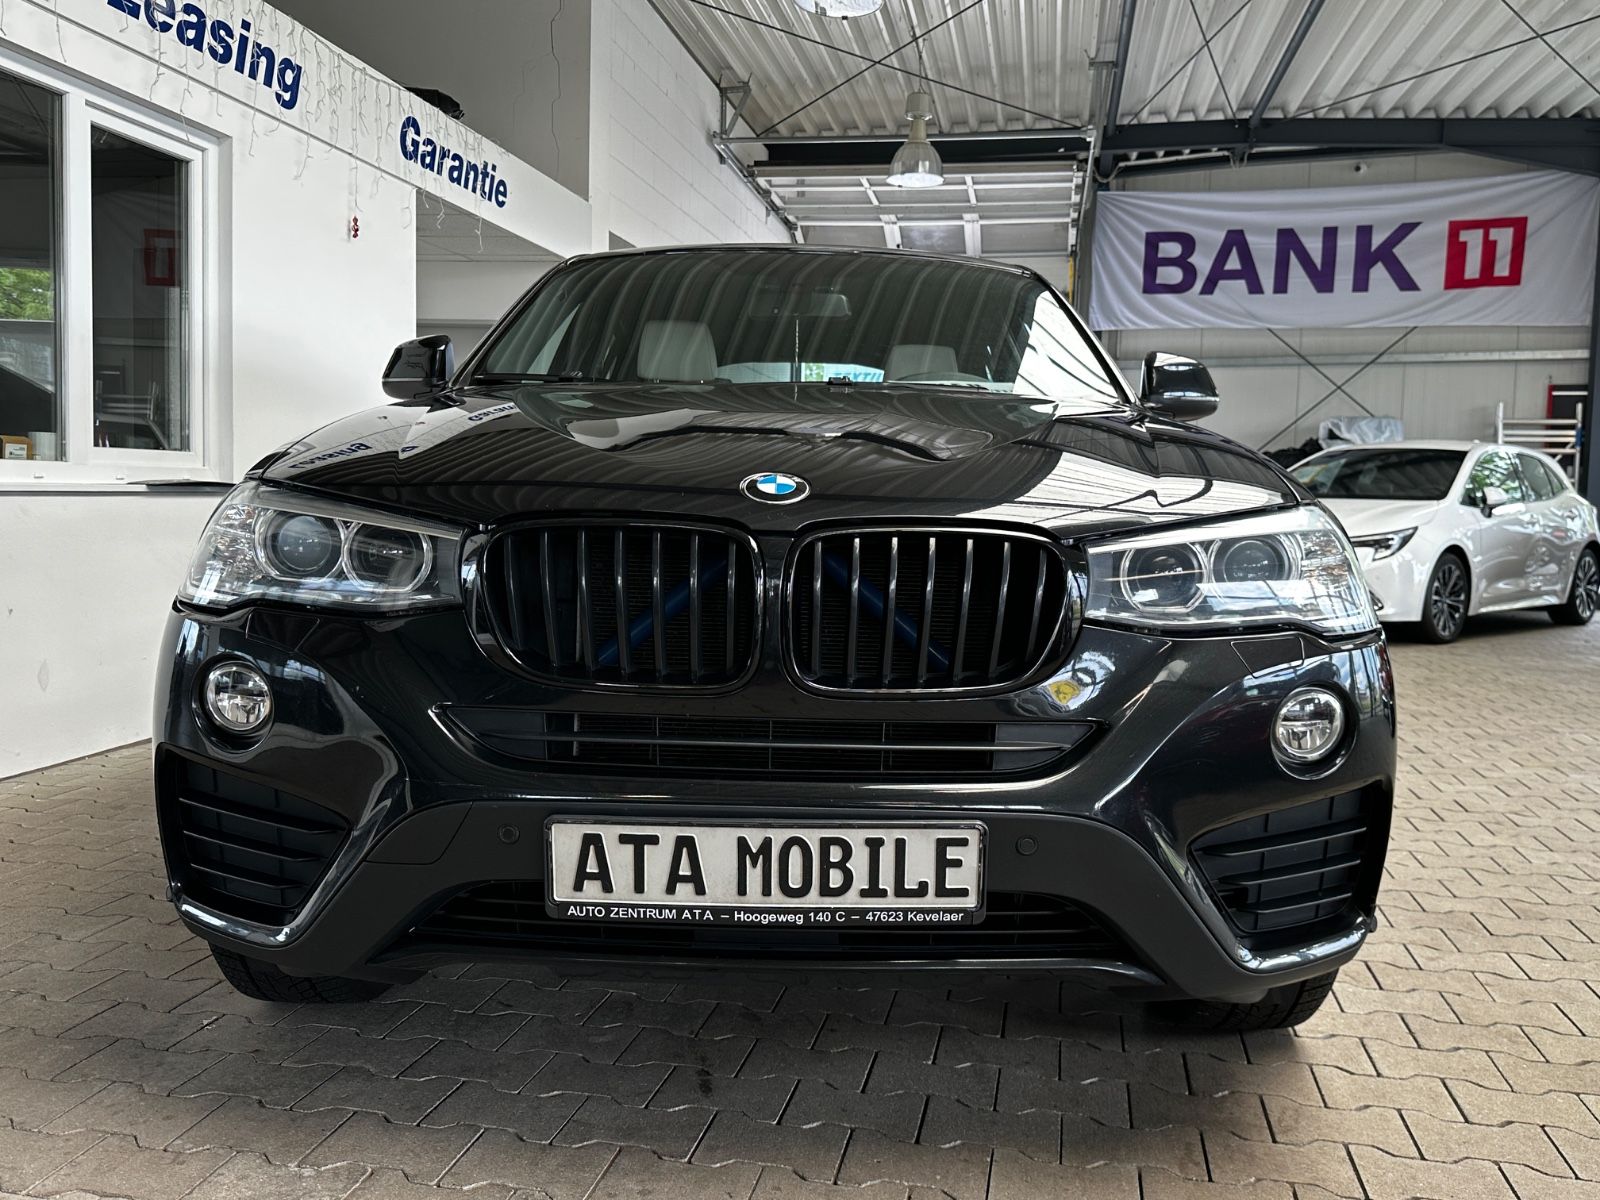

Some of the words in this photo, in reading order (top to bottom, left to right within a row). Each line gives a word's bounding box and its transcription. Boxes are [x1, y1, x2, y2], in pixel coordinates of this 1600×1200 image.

[107, 0, 303, 110] easing
[399, 115, 508, 208] Garantie
[1142, 221, 1423, 296] BANK
[1456, 225, 1516, 282] 11
[573, 832, 708, 896] ATA
[736, 834, 971, 899] MOBILE
[567, 905, 606, 917] AUTO
[609, 907, 677, 920] ZENTRUM
[734, 911, 804, 925] Hoogeweg
[808, 912, 831, 922] 140
[835, 912, 846, 922] C
[865, 911, 904, 922] 47623
[907, 911, 964, 922] Kevelaer
